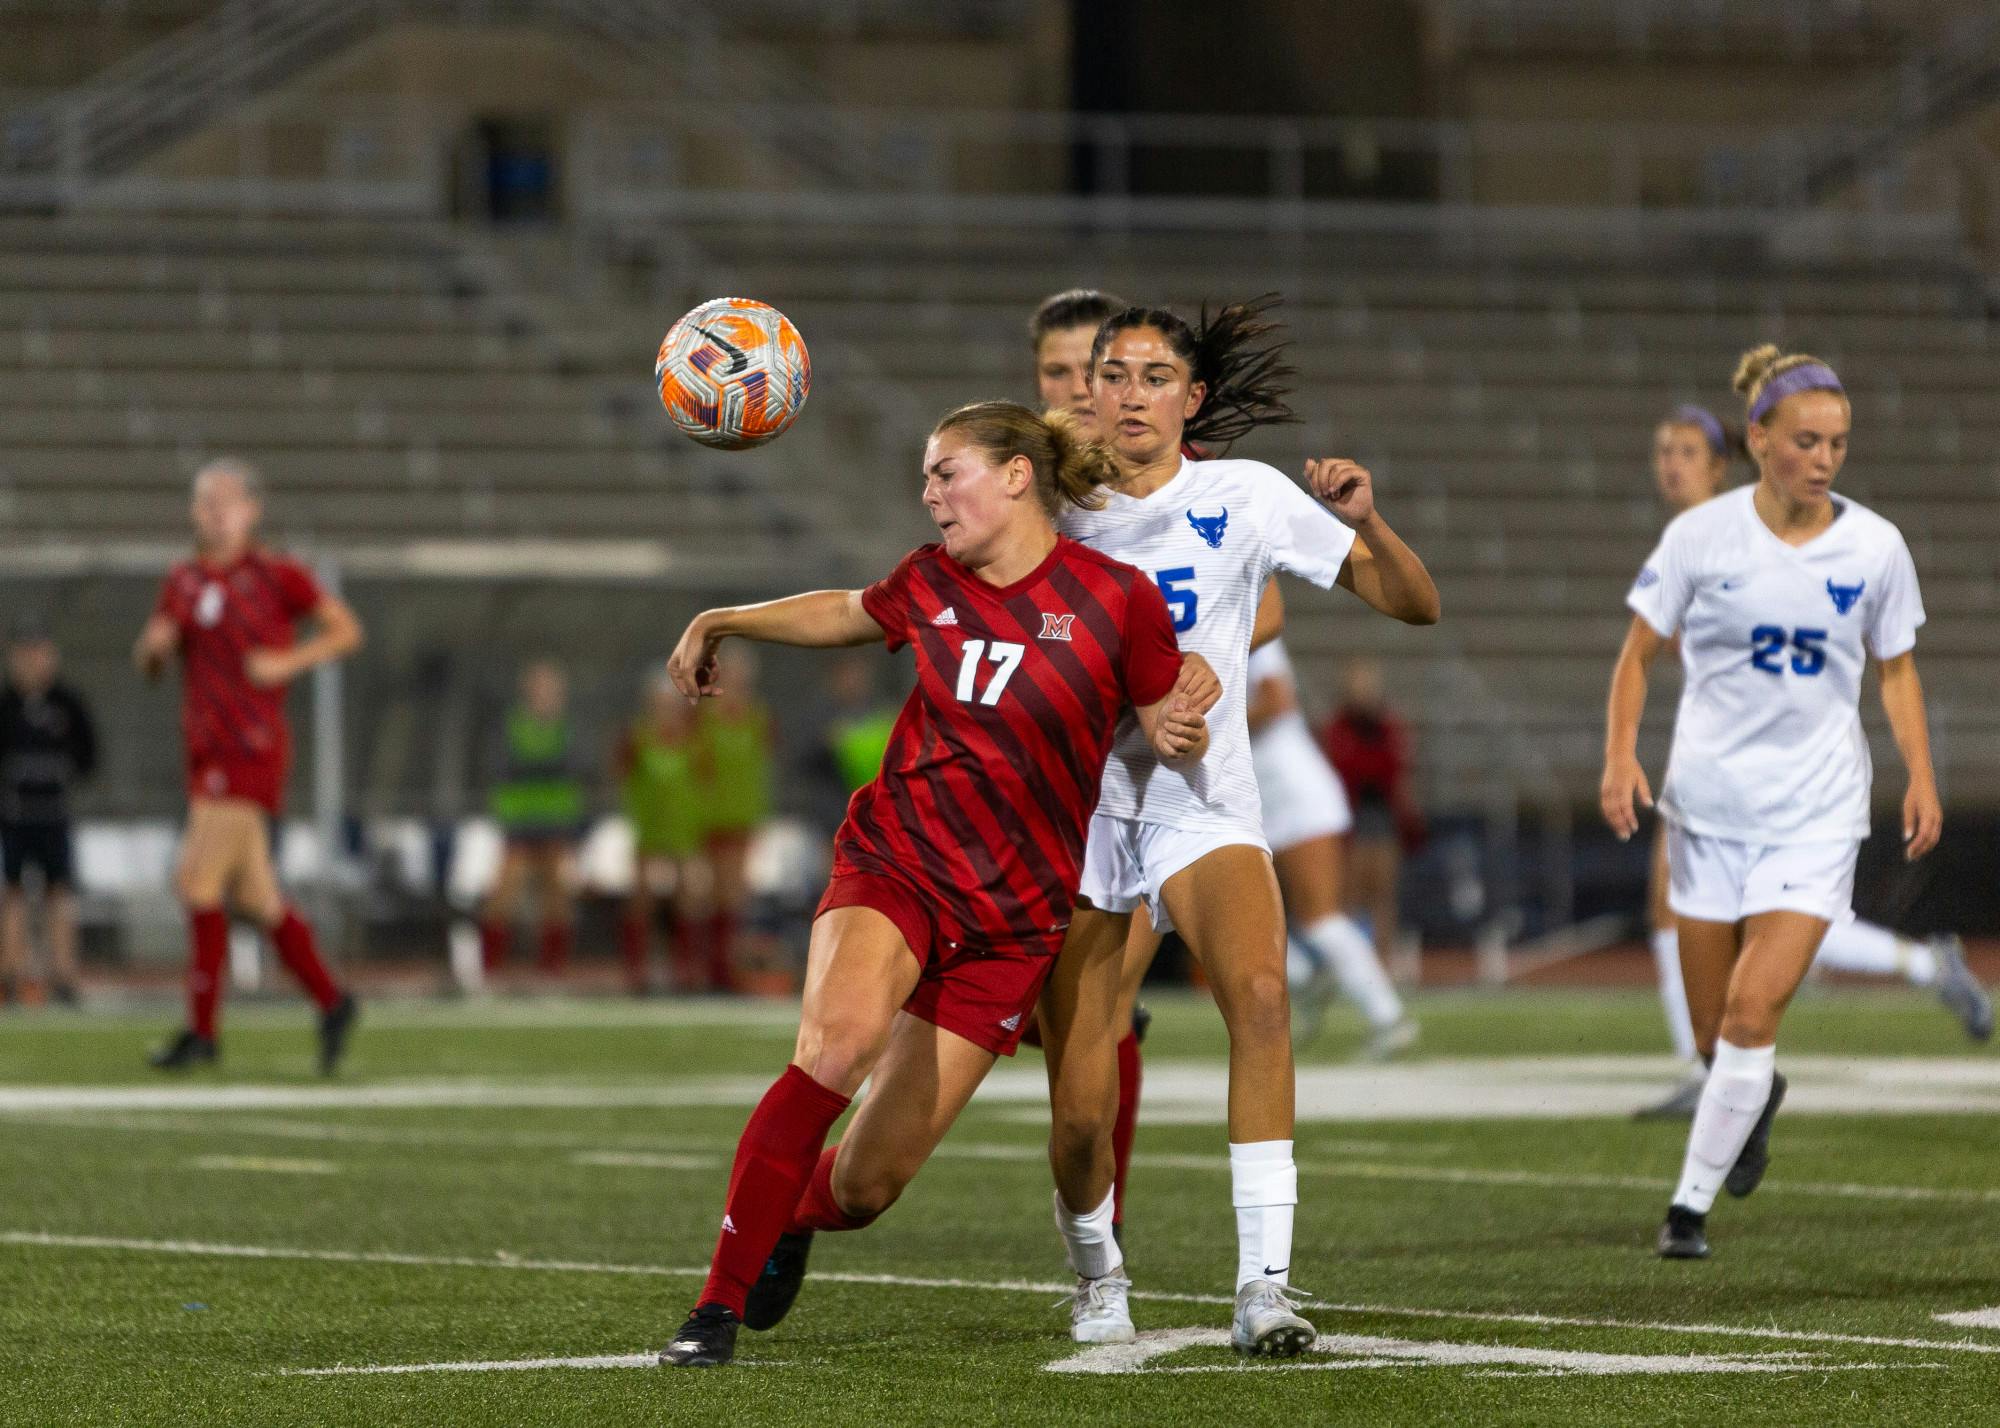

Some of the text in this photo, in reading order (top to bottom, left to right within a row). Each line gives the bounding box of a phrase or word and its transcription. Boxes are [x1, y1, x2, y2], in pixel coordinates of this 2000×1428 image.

[1038, 613, 1076, 641] M
[1751, 624, 1827, 677] 25
[956, 639, 1026, 706] 17
